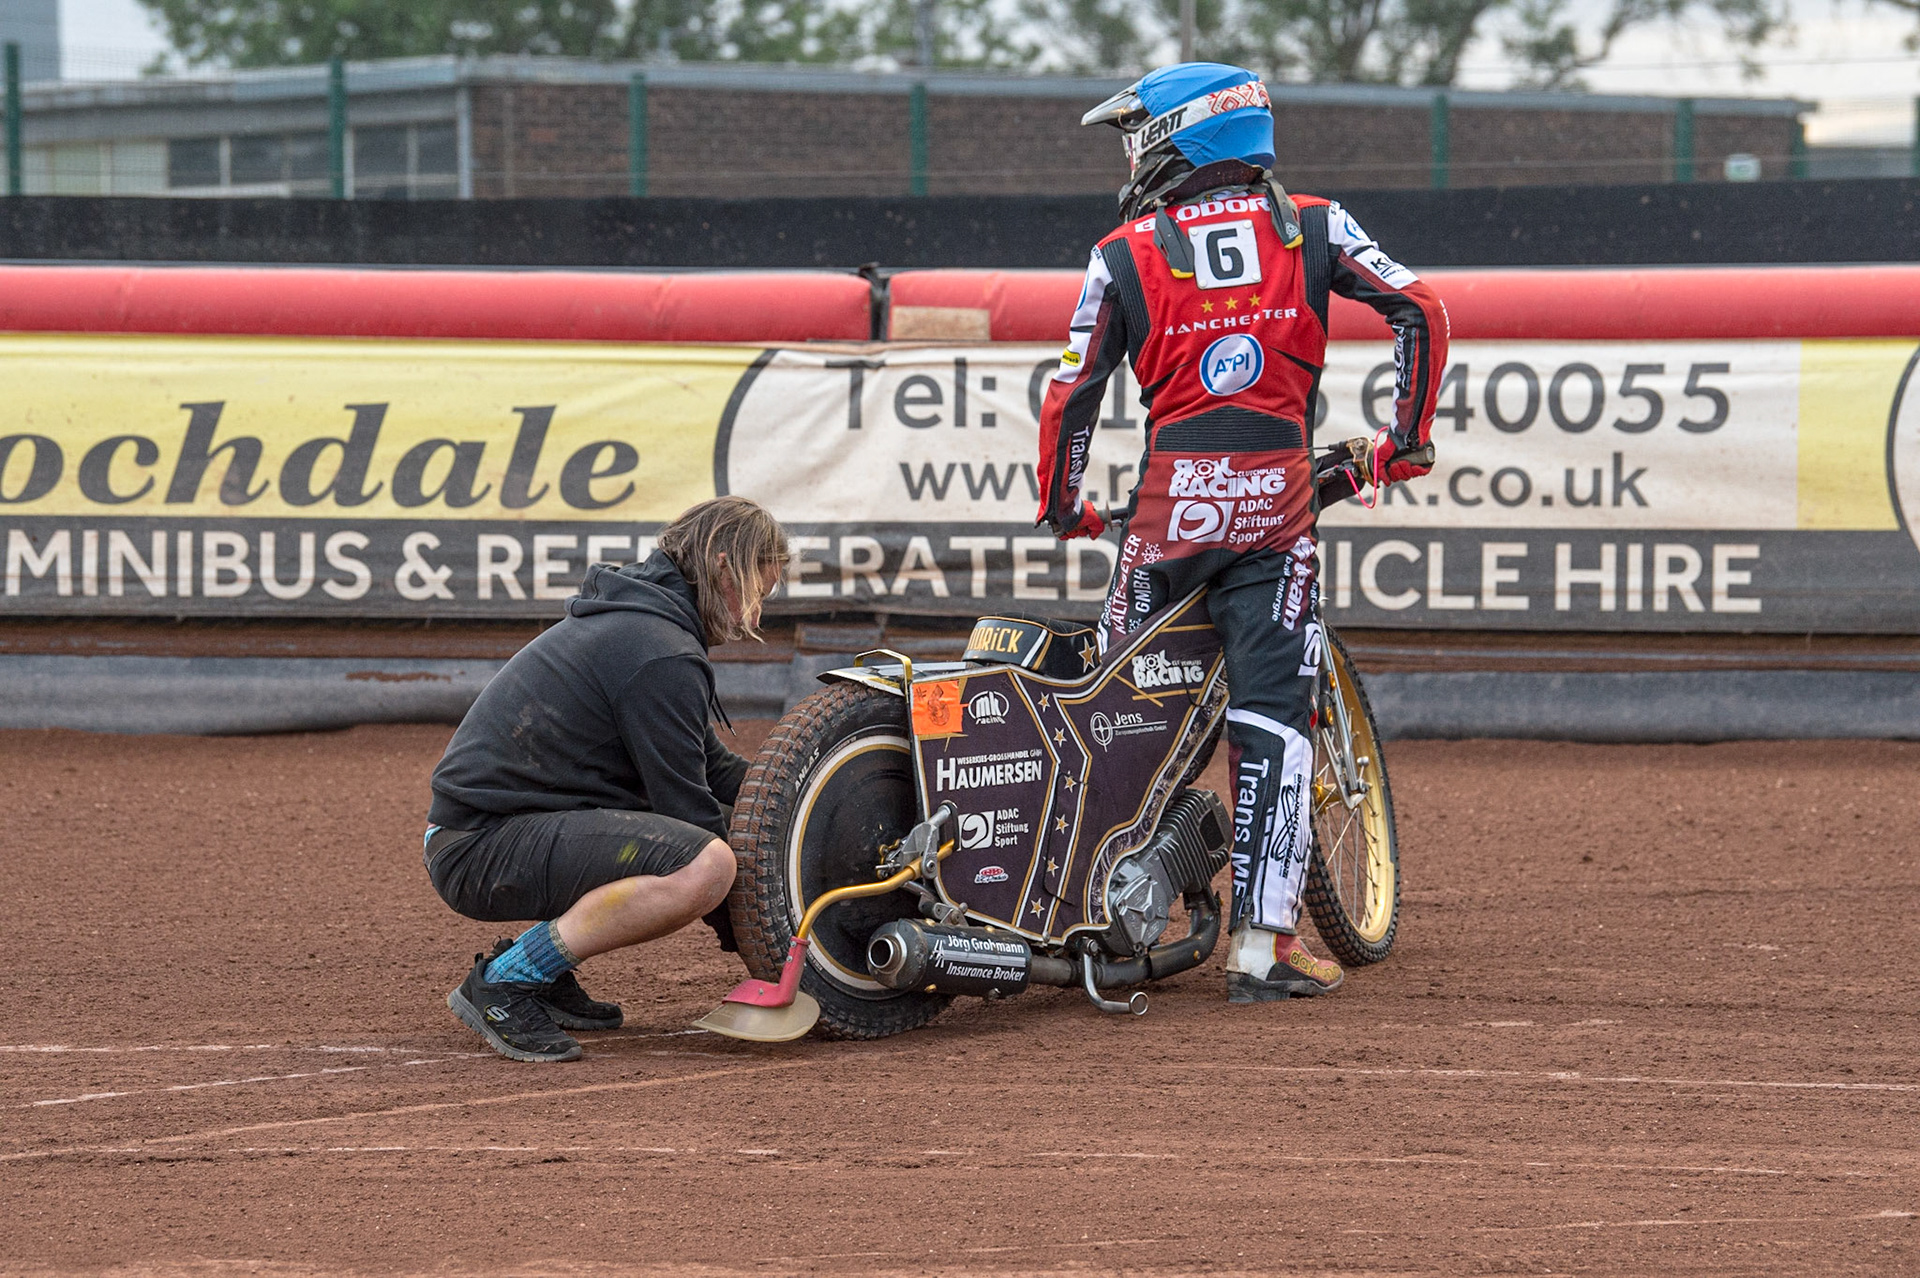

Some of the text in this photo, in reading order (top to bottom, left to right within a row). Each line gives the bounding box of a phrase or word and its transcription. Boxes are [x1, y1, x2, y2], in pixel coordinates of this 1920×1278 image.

[1206, 228, 1244, 281] 6
[826, 357, 998, 430] Tel:
[1168, 473, 1287, 498] RACING
[1238, 498, 1273, 513] ADAC
[1234, 514, 1286, 530] Stiftung
[1228, 530, 1266, 544] Sport
[5, 528, 374, 600] MINIBUS
[393, 530, 456, 600] &
[1316, 539, 1530, 610] ICLE
[1555, 542, 1763, 614] HIRE
[1133, 665, 1205, 688] RACING
[1114, 711, 1144, 726] Jens
[936, 757, 1043, 792] HAUMERSEN
[1234, 758, 1270, 843] Trans
[996, 808, 1020, 821] ADAC
[995, 822, 1029, 835] Stiftung
[994, 834, 1018, 848] Sport
[948, 934, 971, 952] Jörg
[946, 962, 1026, 982] Insurance Broker
